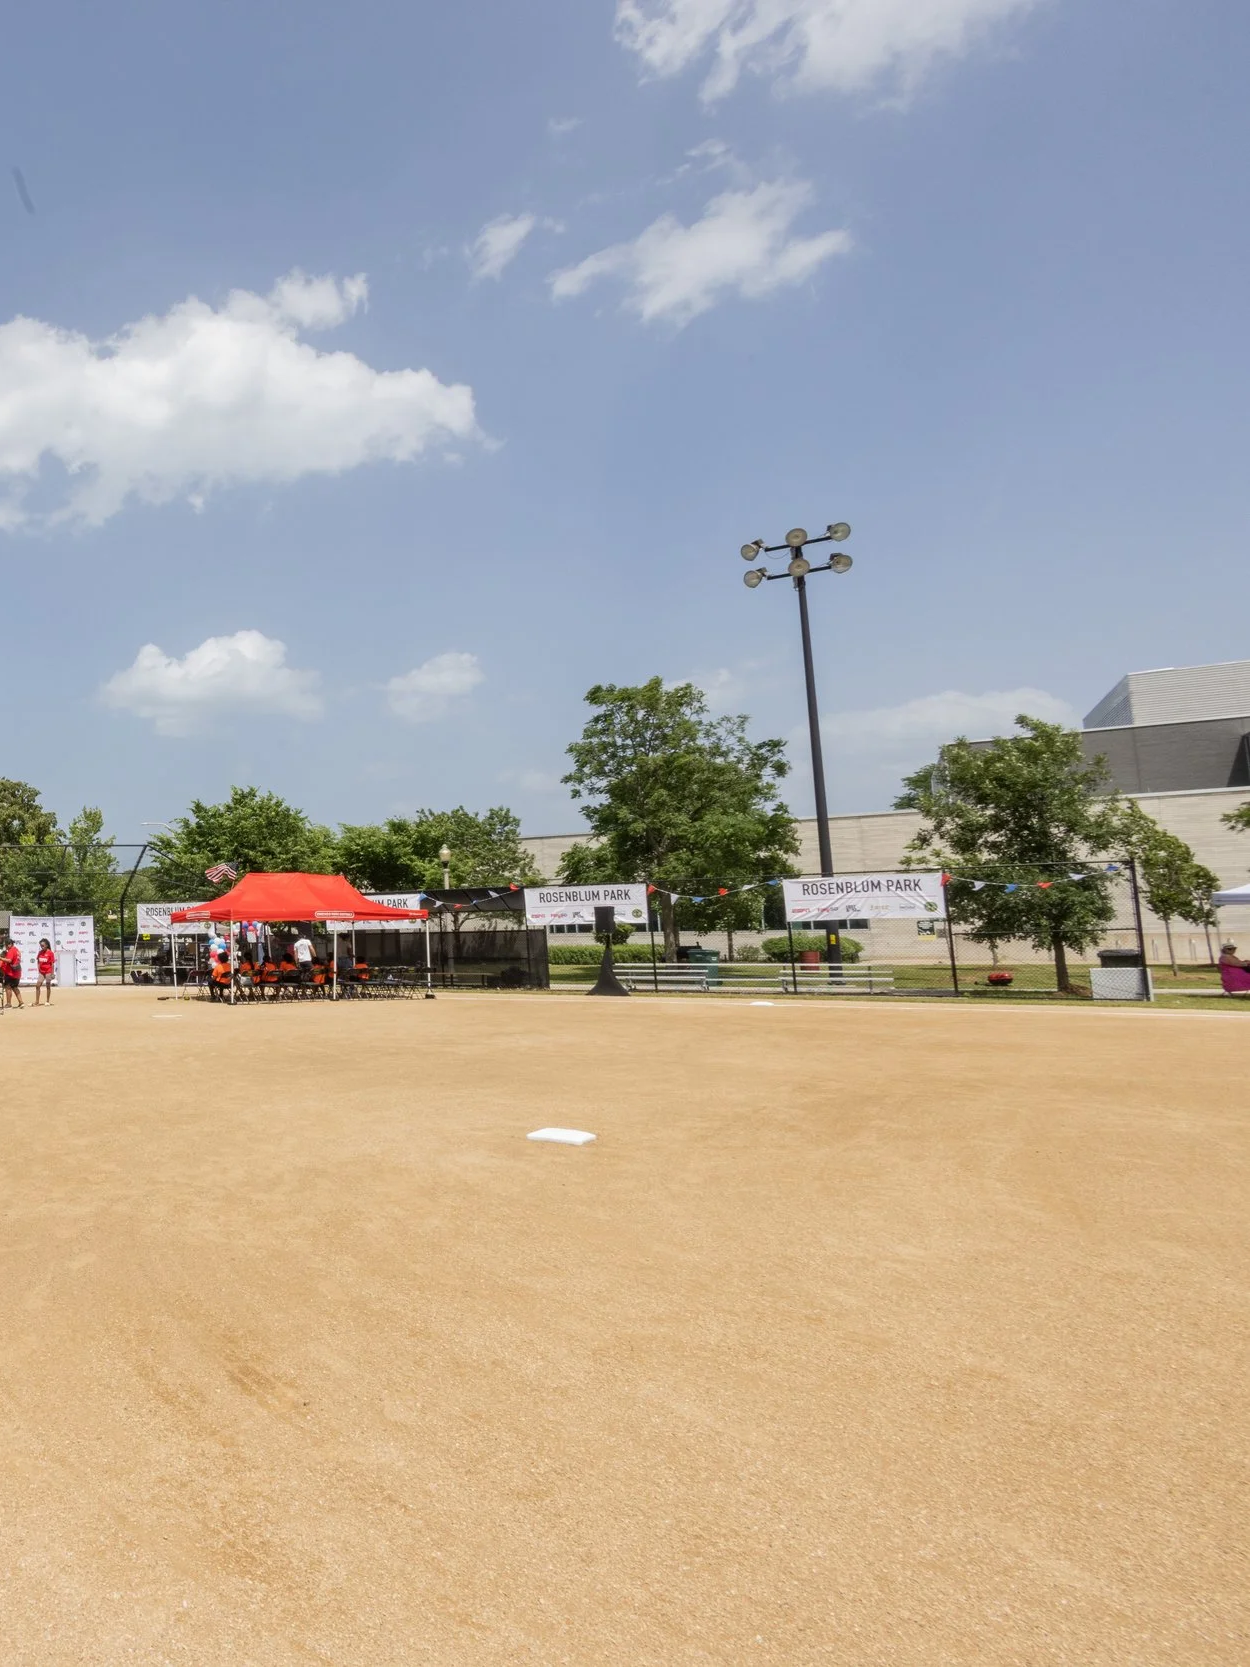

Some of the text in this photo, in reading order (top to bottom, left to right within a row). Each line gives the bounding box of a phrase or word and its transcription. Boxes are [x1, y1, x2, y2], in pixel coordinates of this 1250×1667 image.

[802, 878, 923, 896] ROSENBLUM PARK
[539, 889, 631, 903] ROSENBLUM PARK
[387, 898, 408, 908] PARK
[145, 906, 185, 917] ROSENB
